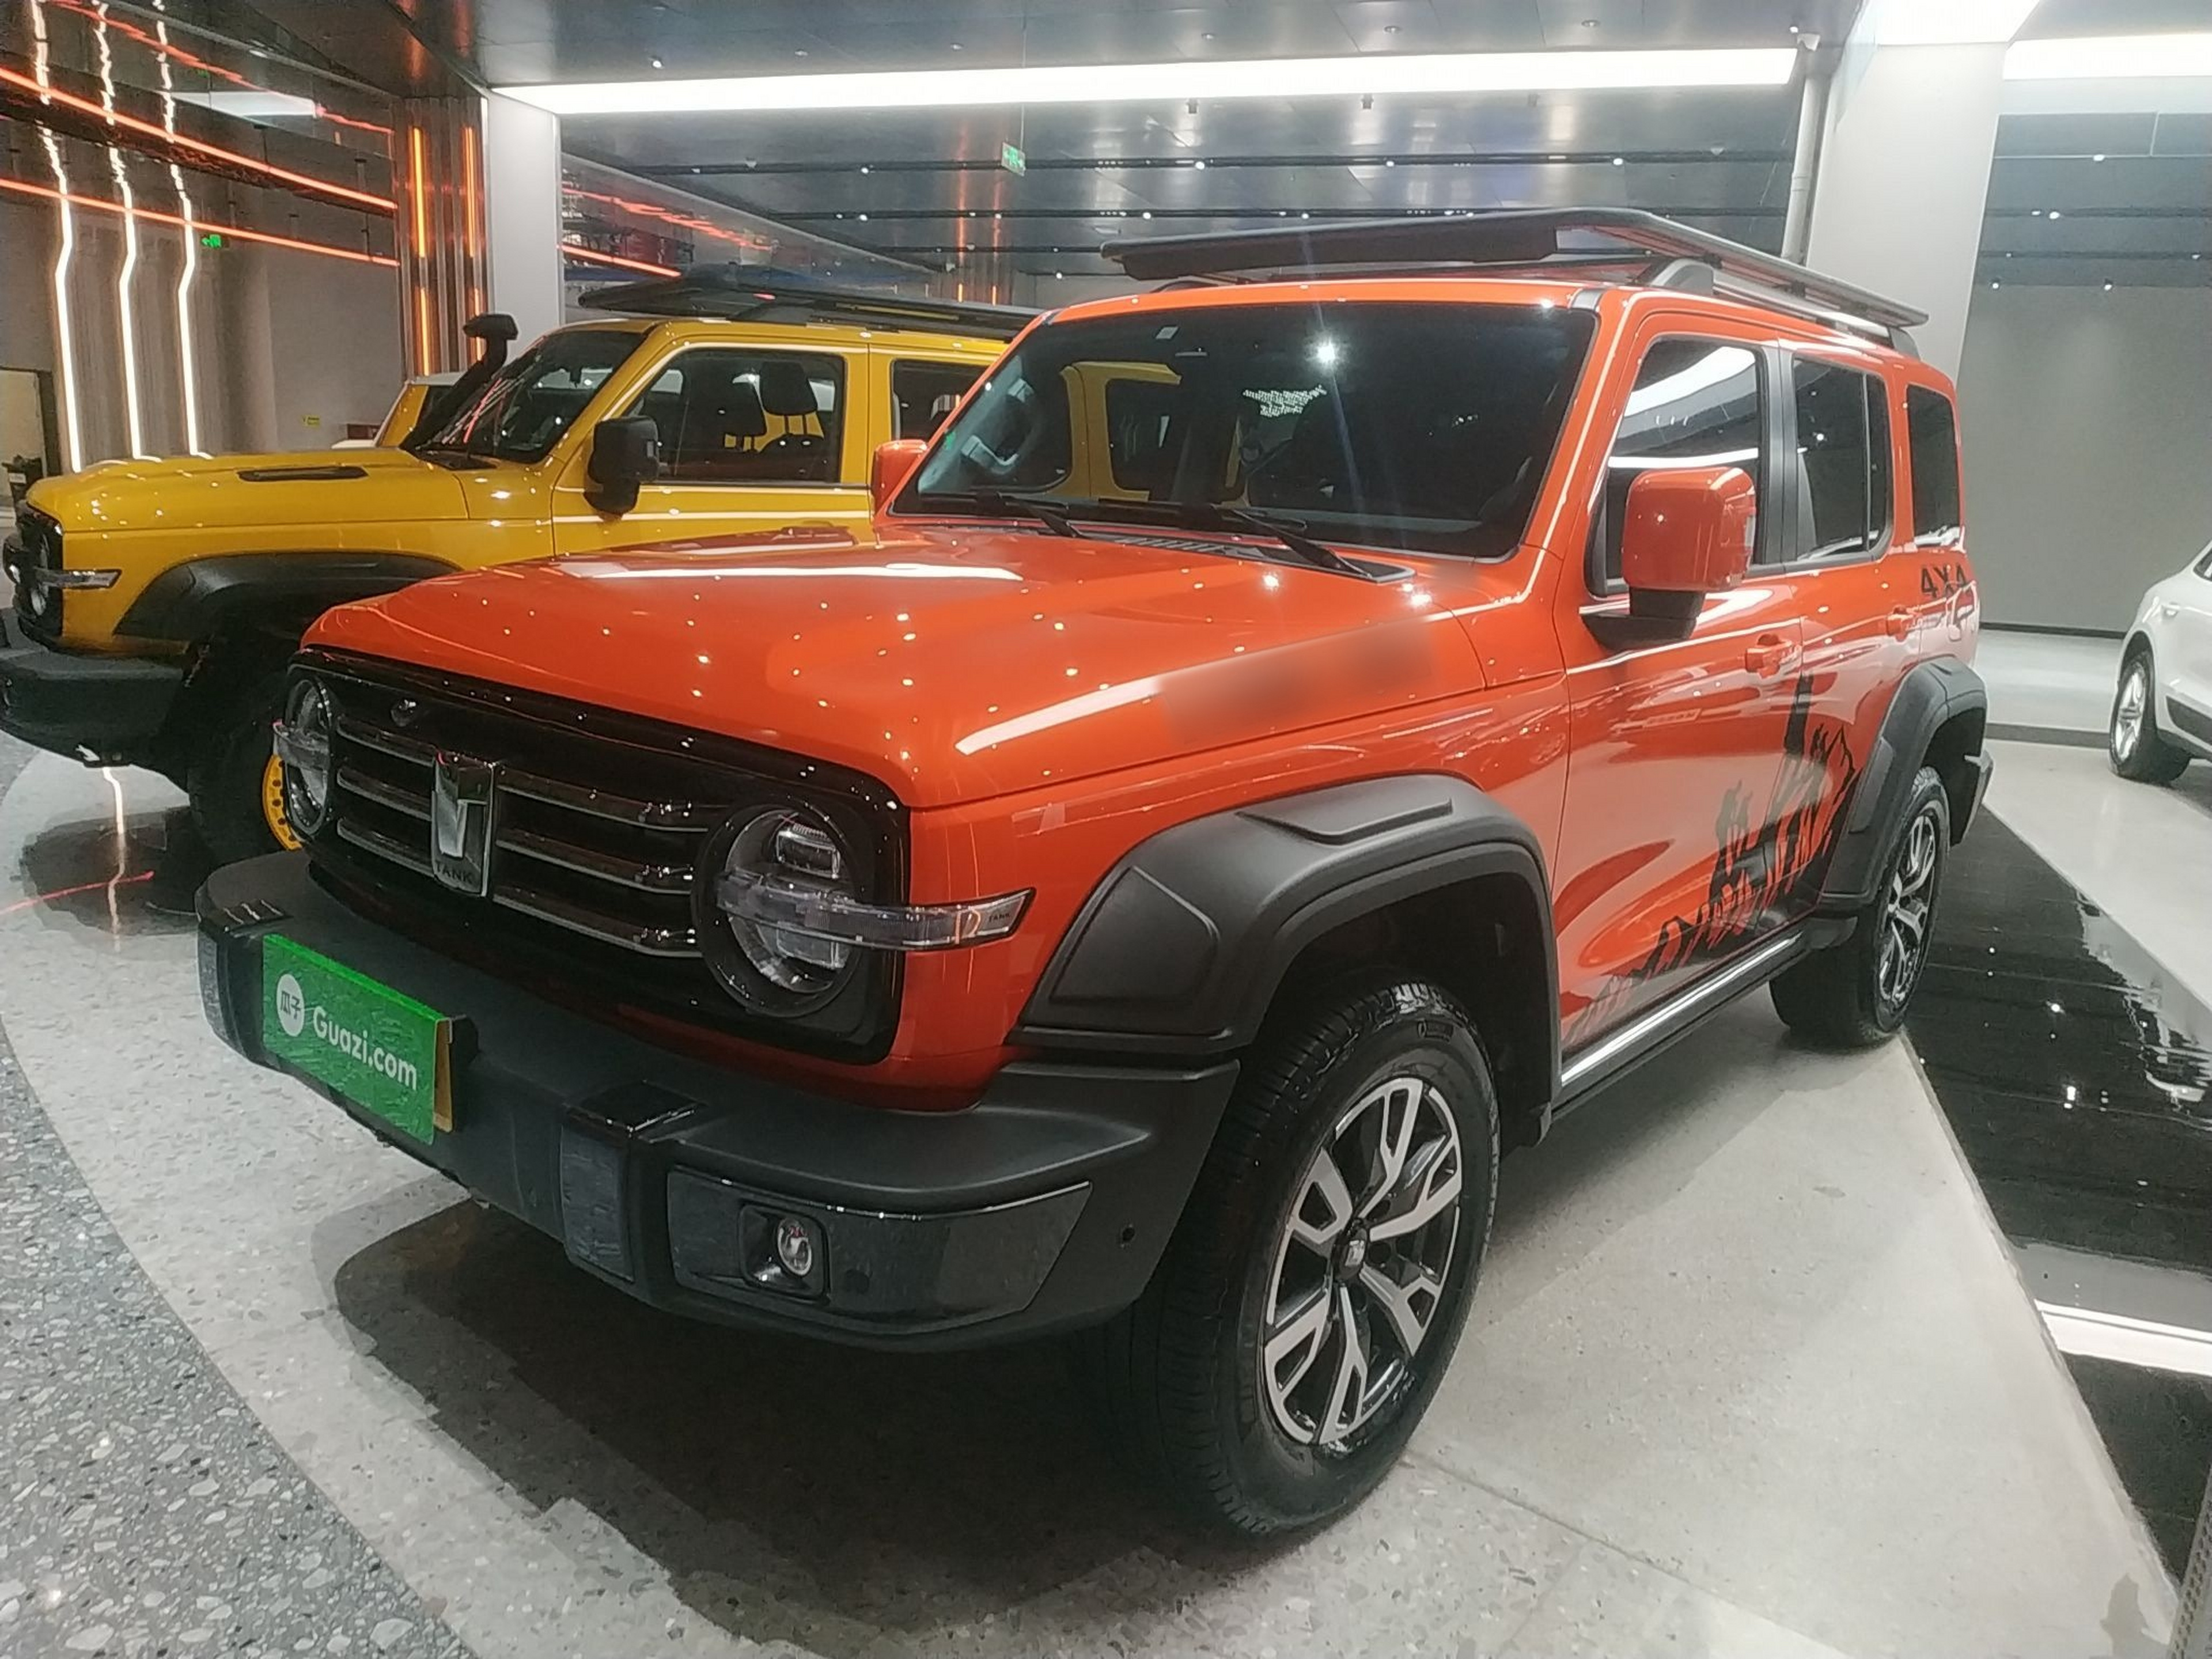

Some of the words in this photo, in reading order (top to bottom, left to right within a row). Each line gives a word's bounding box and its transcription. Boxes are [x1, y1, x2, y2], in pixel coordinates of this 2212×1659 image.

[435, 859, 474, 885] TANK
[281, 990, 301, 1020] 瓜子
[313, 1005, 417, 1090] Guazi.com
